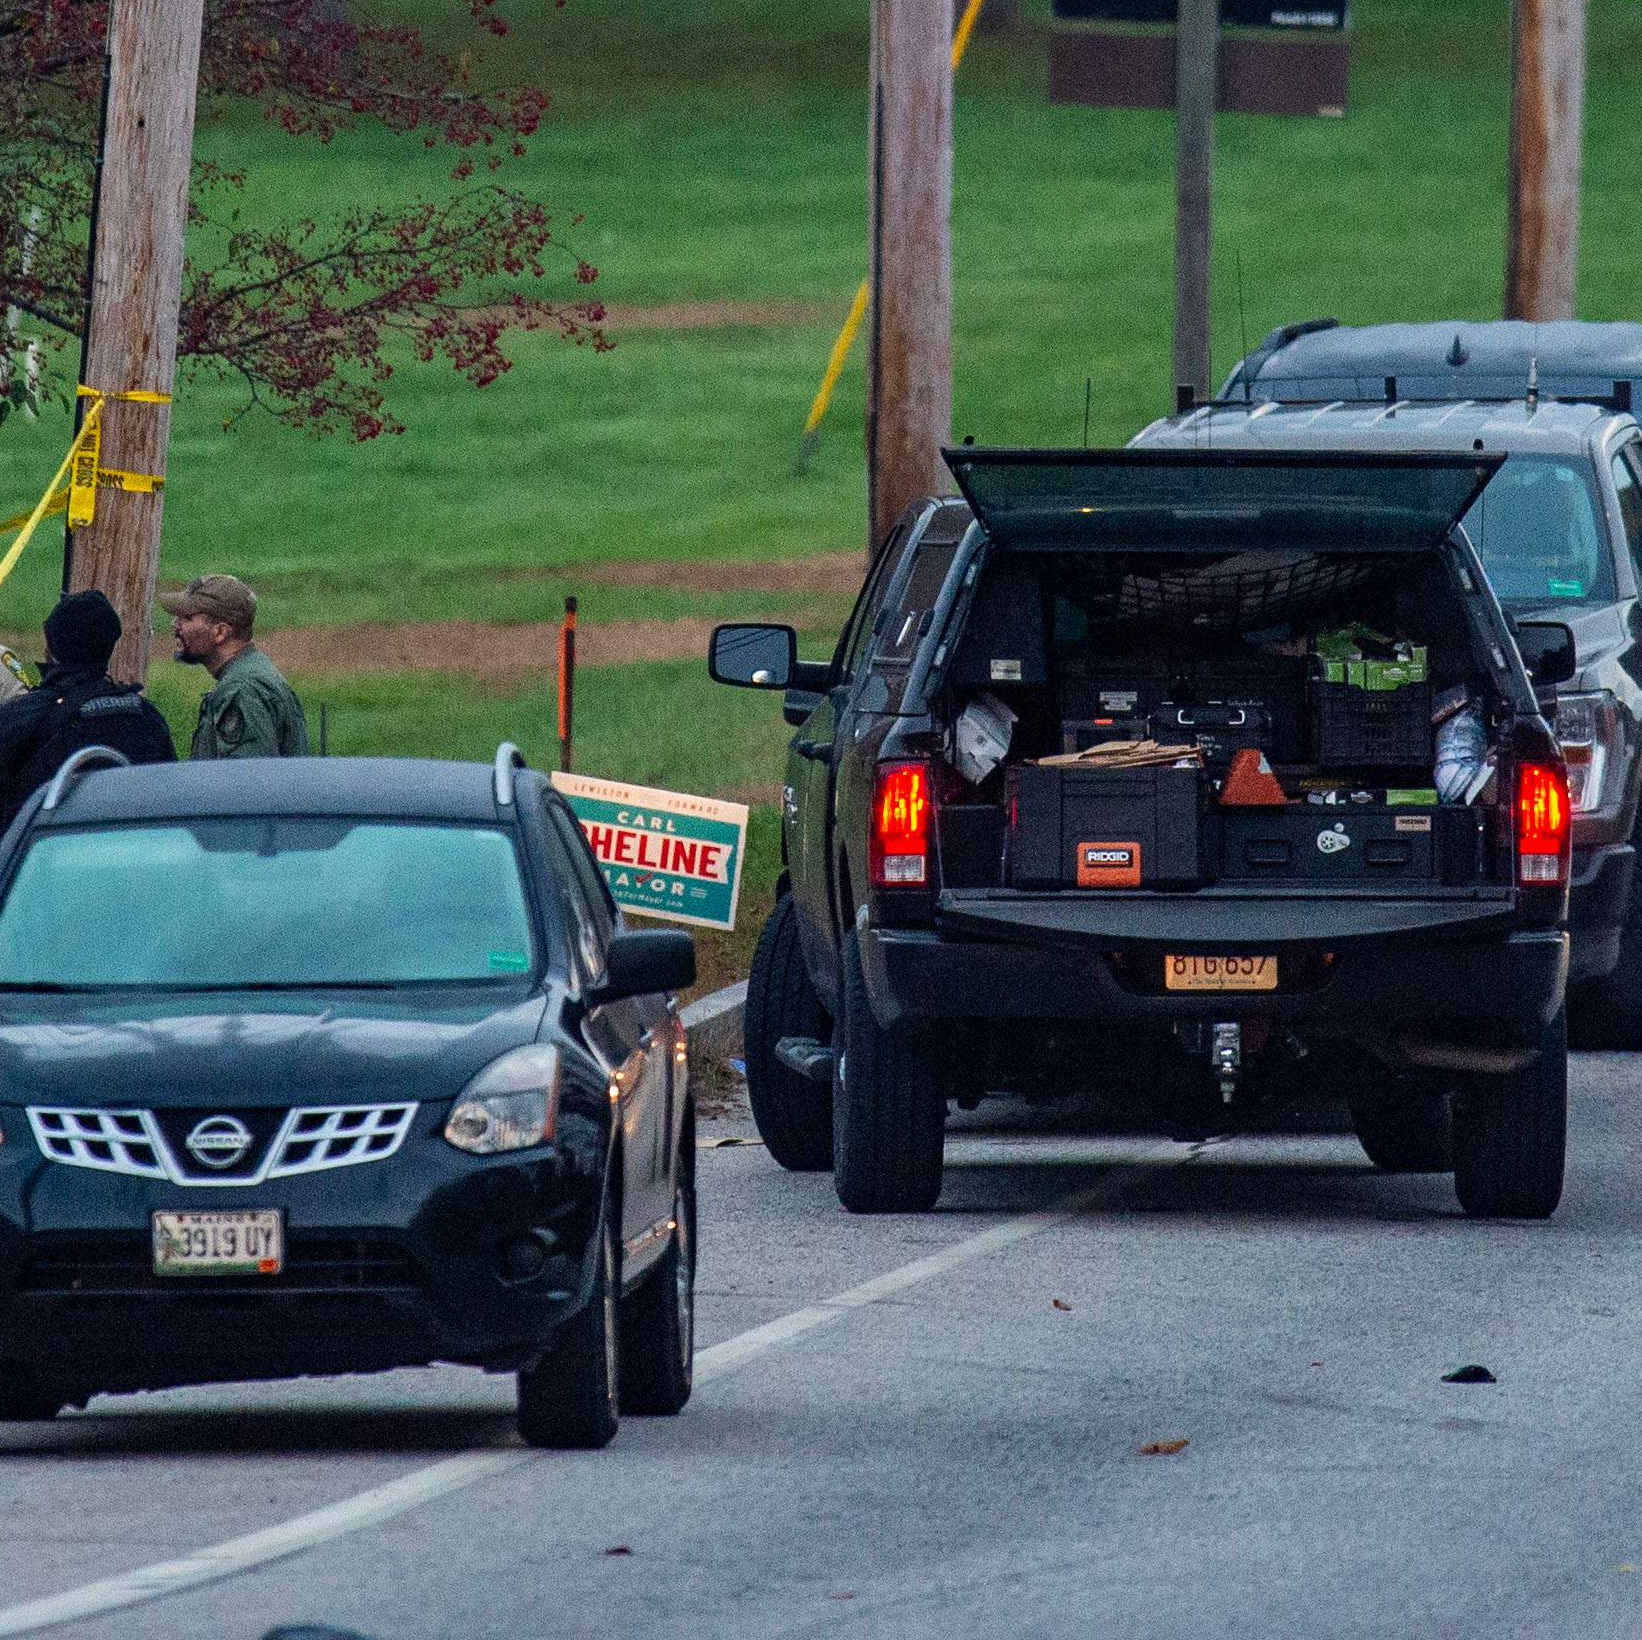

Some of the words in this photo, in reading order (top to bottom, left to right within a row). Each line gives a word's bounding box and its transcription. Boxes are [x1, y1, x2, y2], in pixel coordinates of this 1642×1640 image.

[573, 782, 630, 798] LEWISTON
[667, 799, 720, 815] FORWARD
[617, 811, 676, 832] CARL
[1087, 851, 1130, 861] RIDGID
[193, 1136, 244, 1145] NISSAN
[180, 1227, 237, 1257] 3919
[245, 1226, 273, 1256] UY
